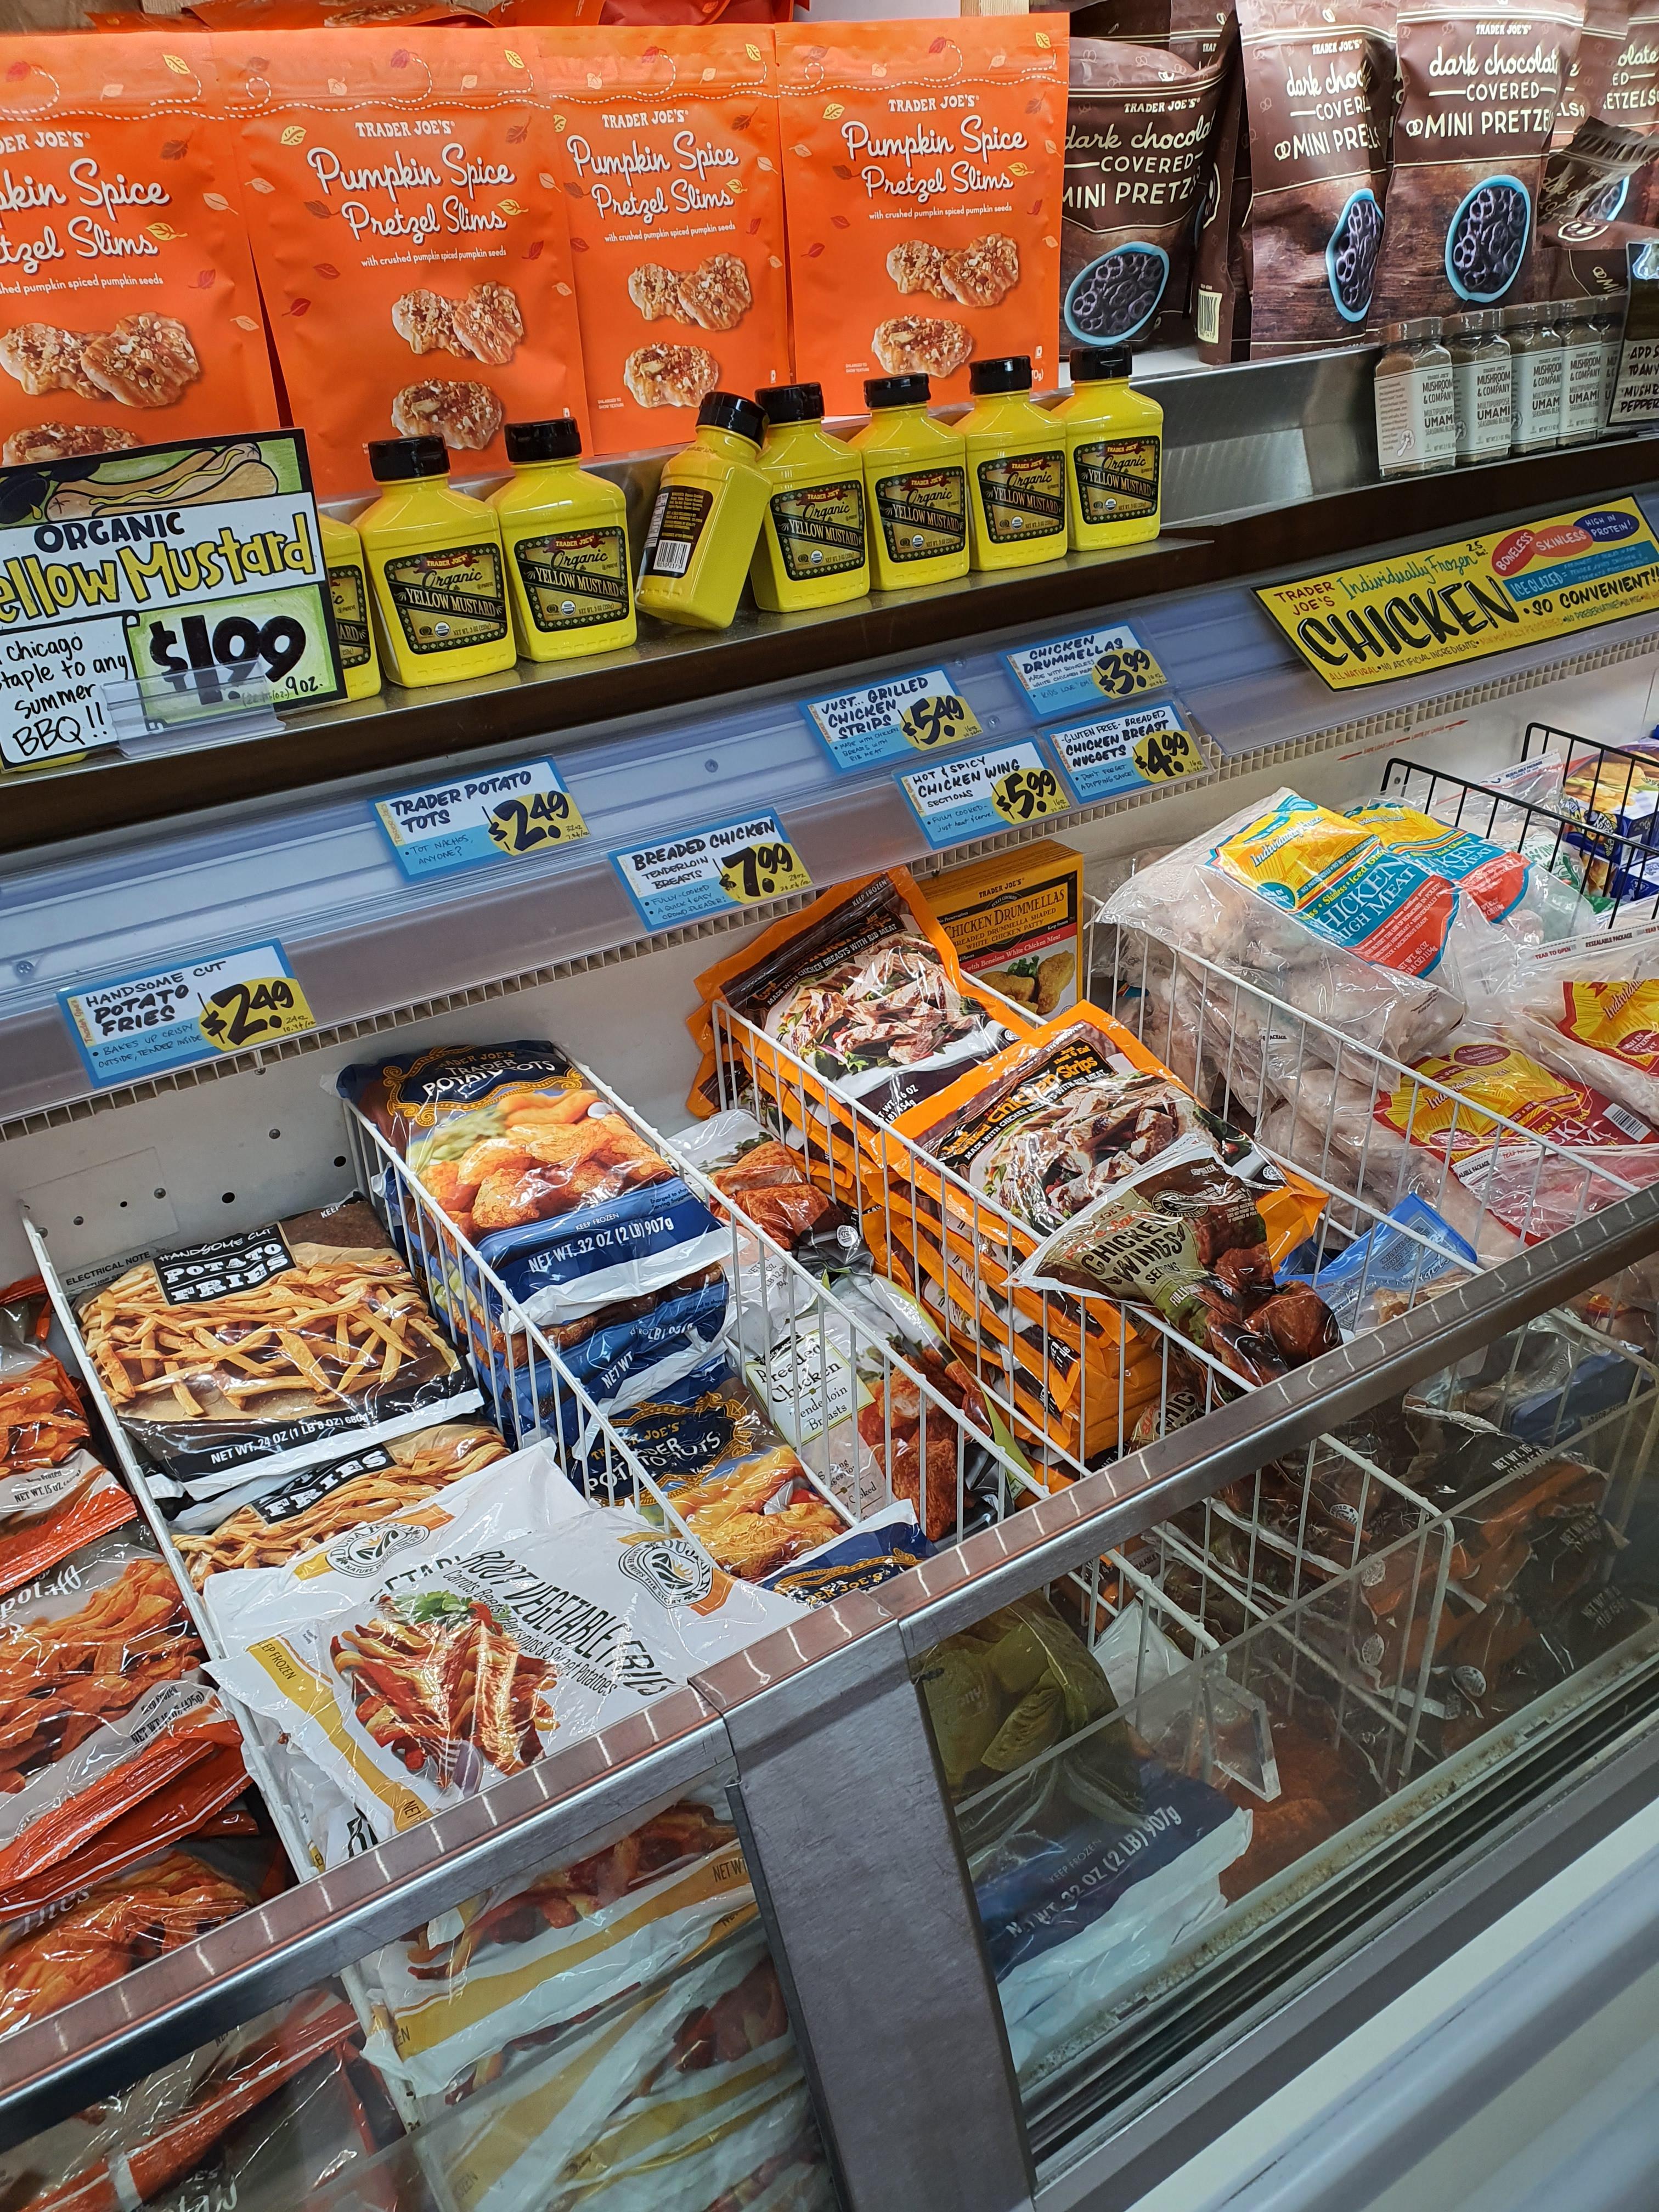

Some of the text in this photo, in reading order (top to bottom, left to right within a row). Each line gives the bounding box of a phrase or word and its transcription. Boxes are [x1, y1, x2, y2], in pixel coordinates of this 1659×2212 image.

[1476, 24, 1505, 35] TRADER
[1429, 45, 1480, 77] dark
[1286, 65, 1322, 97] dark
[1466, 81, 1540, 101] COVERED
[888, 95, 975, 112] TRADER JOE'S
[1124, 98, 1196, 113] TRADER JOE'S
[355, 120, 452, 137] TRADER JOE'S
[1425, 112, 1473, 138] MINI
[35, 131, 84, 148] JOE'S
[841, 114, 1028, 167] Pumpkin Spice
[1293, 132, 1330, 159] MINI
[307, 143, 515, 202] Pumpkin Spice
[566, 130, 740, 187] Pumpkin Spice
[1101, 153, 1194, 173] COVERED
[69, 157, 170, 221] Spice
[861, 160, 1014, 203] Pretzel Slims
[591, 178, 733, 224] Pretzel Slims
[341, 195, 506, 245] Pretzel Slims
[68, 216, 158, 257] Slims
[361, 245, 506, 267] with crushed pumpkin spiced pumpkin seeds
[1477, 371, 1510, 386] MUSHROOM
[1483, 383, 1510, 397] COMPANY
[1477, 405, 1510, 420] UMAMI
[1101, 455, 1146, 473] Organic
[1088, 469, 1152, 496] YELLOW MUSTARD
[803, 502, 850, 522] Organic
[34, 512, 185, 553] ORGANIC
[789, 518, 859, 545] YELLOW MUSTARD
[1536, 529, 1587, 552] SKINLESS
[1591, 520, 1633, 537] PROTEIN!
[117, 512, 315, 603] Mustard
[550, 549, 608, 571] Organic
[1496, 531, 1534, 572] BONELESS
[422, 568, 482, 592] Organic
[535, 567, 619, 597] YELLOW MUSTARD
[1336, 554, 1477, 601] Individually Frozen
[405, 587, 496, 617] YELLOW MUSTARD
[1273, 582, 1335, 603] TRADER
[1293, 596, 1335, 616] JOE'S
[1297, 575, 1519, 665] CHICKEN
[1532, 598, 1553, 616] SO
[1023, 637, 1124, 674] DRUMMELLAS
[1029, 635, 1095, 660] CHICKEN
[1393, 642, 1476, 669] ARTIFICIAL INGREDIENTS
[61, 653, 129, 680] to any
[868, 677, 928, 703] GRILLED
[828, 699, 896, 728] CHICKEN
[838, 714, 891, 740] STRIPS
[1125, 710, 1165, 727] BREADED
[1066, 733, 1119, 757] CHICKEN
[1122, 719, 1169, 741] BREAST
[1072, 744, 1126, 768] NUGGETS
[912, 756, 986, 785] HOT SPICY
[918, 770, 981, 799] CHICKEN
[985, 759, 1020, 779] WING
[390, 771, 532, 816] TRADER POTATO
[927, 789, 974, 808] SECTIONS
[400, 809, 451, 833] TOTS
[410, 845, 428, 856] TOT
[419, 845, 463, 865] ANYONE?
[631, 819, 775, 871] BREADED CHICKEN
[642, 855, 709, 881] TENDERLOIN
[652, 870, 702, 890] BREASTS
[851, 879, 888, 907] KEEP FROZEN
[979, 879, 1022, 899] TRADER JOE'S
[1367, 866, 1417, 916] MEAT
[994, 889, 1064, 926] DRUMMELLAS
[1030, 907, 1056, 921] SHAPED
[965, 919, 1044, 950] WHITE CHICKEN PATTY
[1585, 933, 1633, 947] RESEALABLE PACKAGE
[798, 947, 851, 977] CHICKEN BREASTS
[981, 933, 1062, 967] Boneless White Chicken Meat
[1558, 947, 1571, 955] OPEN
[86, 961, 227, 1007] HANDSOME CUT
[94, 985, 189, 1025] POTATO
[101, 1005, 176, 1037] FRIES
[103, 1023, 194, 1057] BAKES UP CRISPY
[138, 1041, 175, 1057] TENDER
[176, 1034, 202, 1046] INSIDE
[1056, 1055, 1098, 1079] Strips
[575, 1212, 620, 1231] KEEP FROZEN
[159, 1227, 274, 1262] HANDSOME CUT
[528, 1216, 674, 1273] NET WT. 32 OZ (2 LB) 907g
[1113, 1231, 1183, 1283] WINGS
[66, 1261, 124, 1286] ELECTRICAL
[125, 1251, 151, 1266] NOTE
[163, 1244, 282, 1284] POTATO
[171, 1255, 288, 1301] FRIES
[211, 1431, 289, 1464] NET OZ
[264, 1449, 387, 1517] FRIES
[503, 1582, 617, 1659] VEGETABLE
[269, 1651, 297, 1680] FROZEN
[1119, 1829, 1150, 1858] LB)
